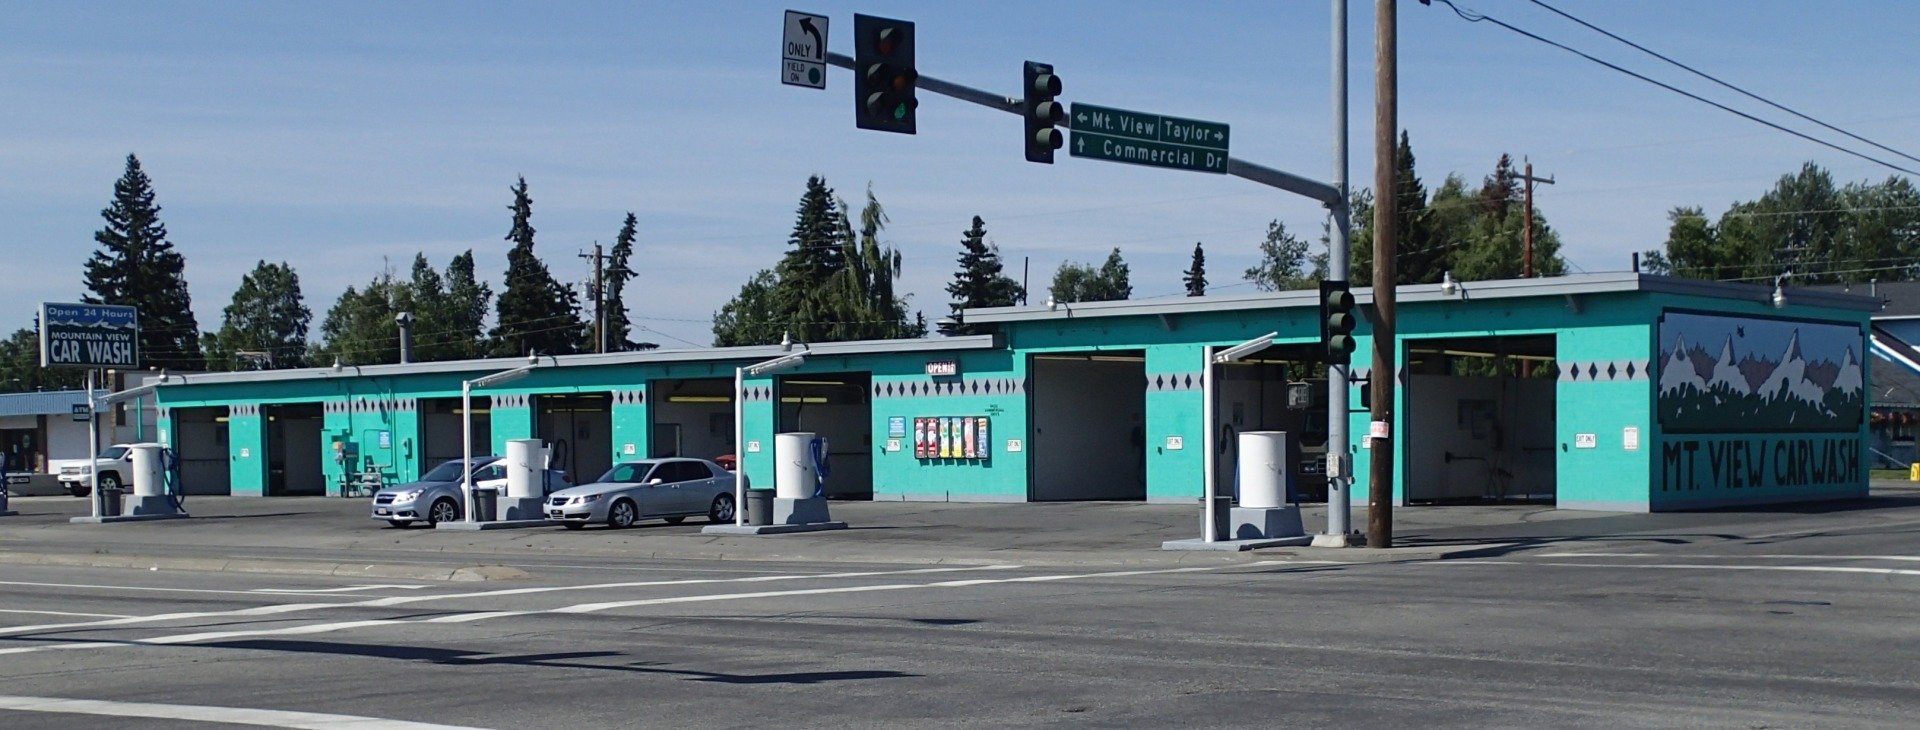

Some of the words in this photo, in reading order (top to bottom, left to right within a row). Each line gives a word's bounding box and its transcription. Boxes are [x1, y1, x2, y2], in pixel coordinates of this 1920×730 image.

[788, 42, 811, 57] ONLY
[787, 62, 805, 72] YIELD
[790, 73, 800, 82] ON
[1092, 111, 1114, 130] Mt.
[1120, 115, 1154, 135] View
[1165, 120, 1209, 142] Taylor
[1103, 139, 1194, 165] Commercial
[1206, 152, 1222, 168] Dr
[48, 307, 78, 317] Open
[84, 308, 97, 316] 24
[102, 309, 133, 318] Hours
[51, 332, 102, 340] MOUNTAIN
[106, 333, 130, 341] VIEW
[50, 340, 80, 362] CAR
[87, 341, 131, 364] WASH
[1662, 440, 1700, 492] MT.
[1708, 439, 1767, 488] VIEW
[1774, 438, 1859, 486] CARWASH
